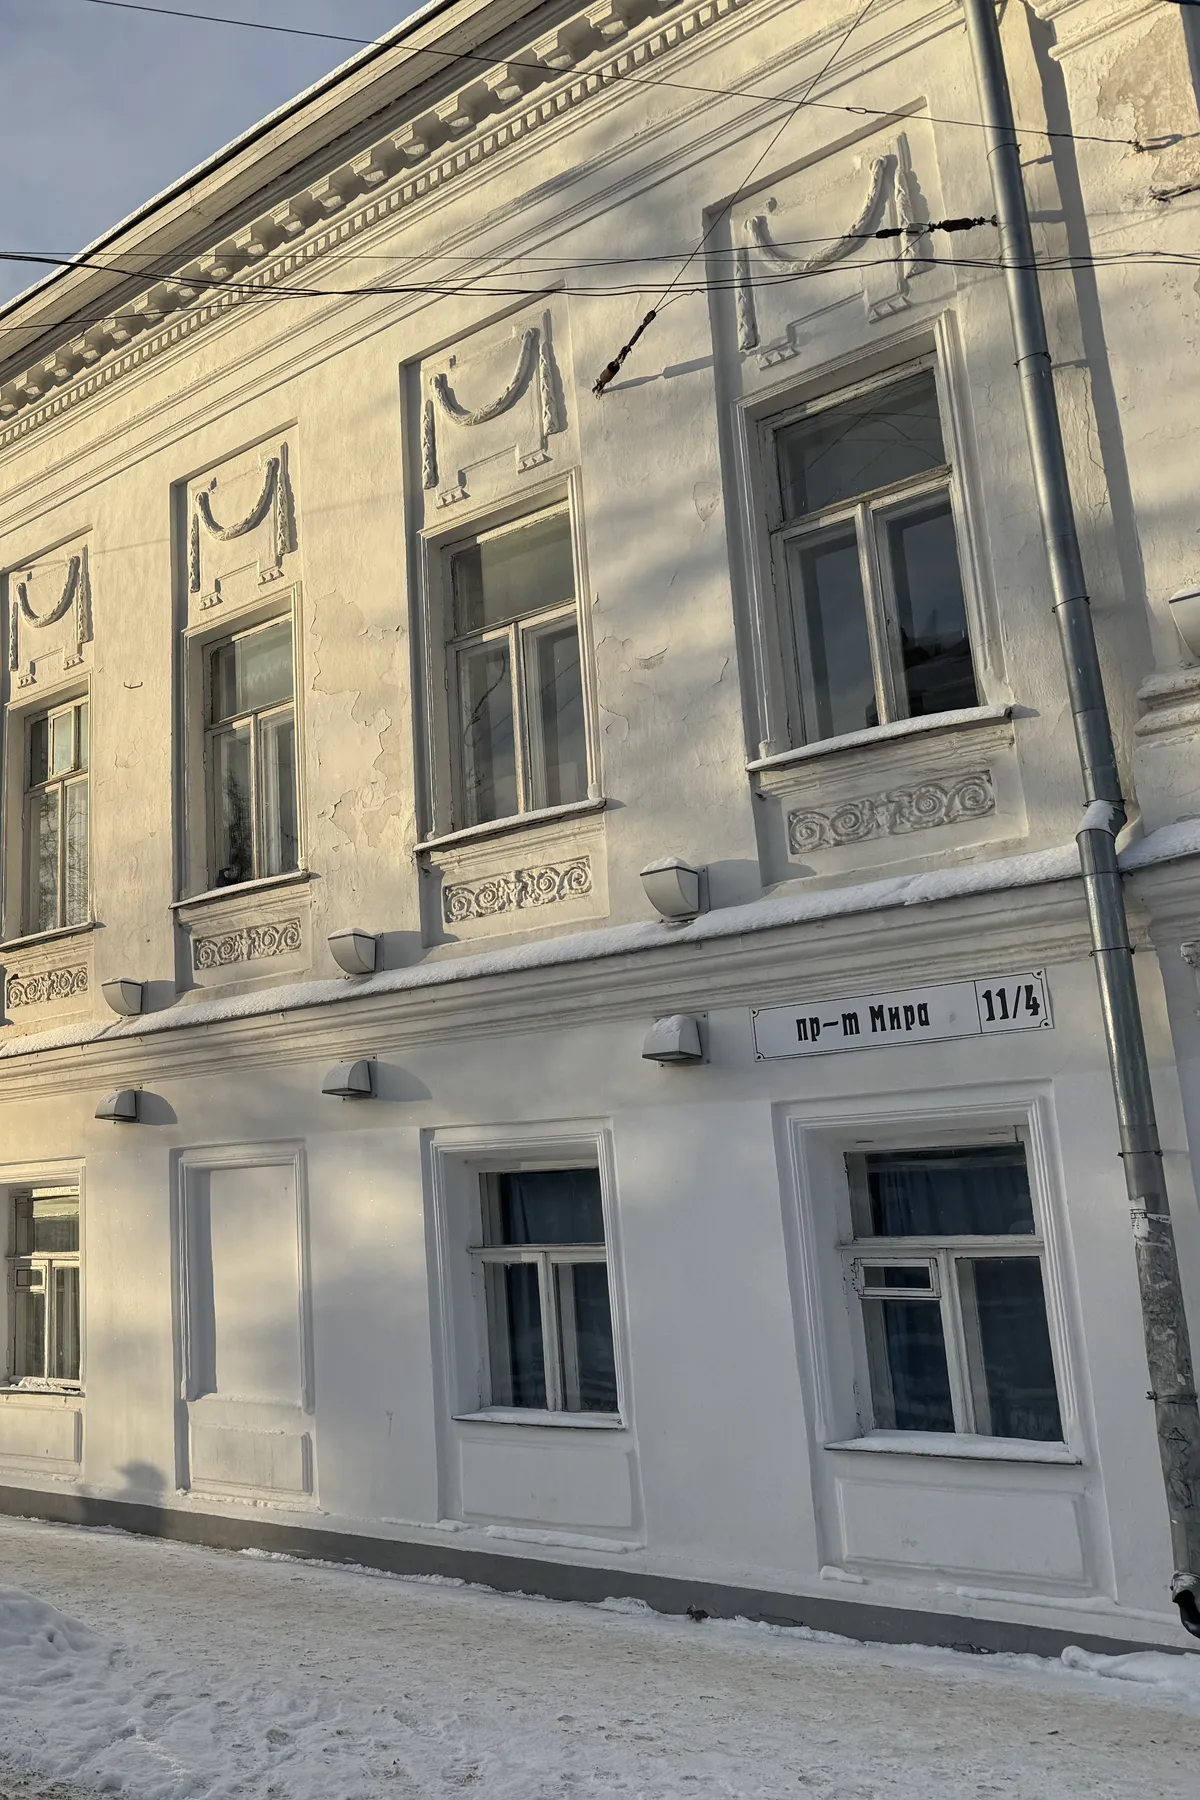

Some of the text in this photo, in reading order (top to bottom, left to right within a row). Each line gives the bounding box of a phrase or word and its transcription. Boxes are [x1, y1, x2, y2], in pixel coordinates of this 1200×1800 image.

[796, 1002, 931, 1041] пр-т Мира
[982, 984, 1040, 1022] 11/4
